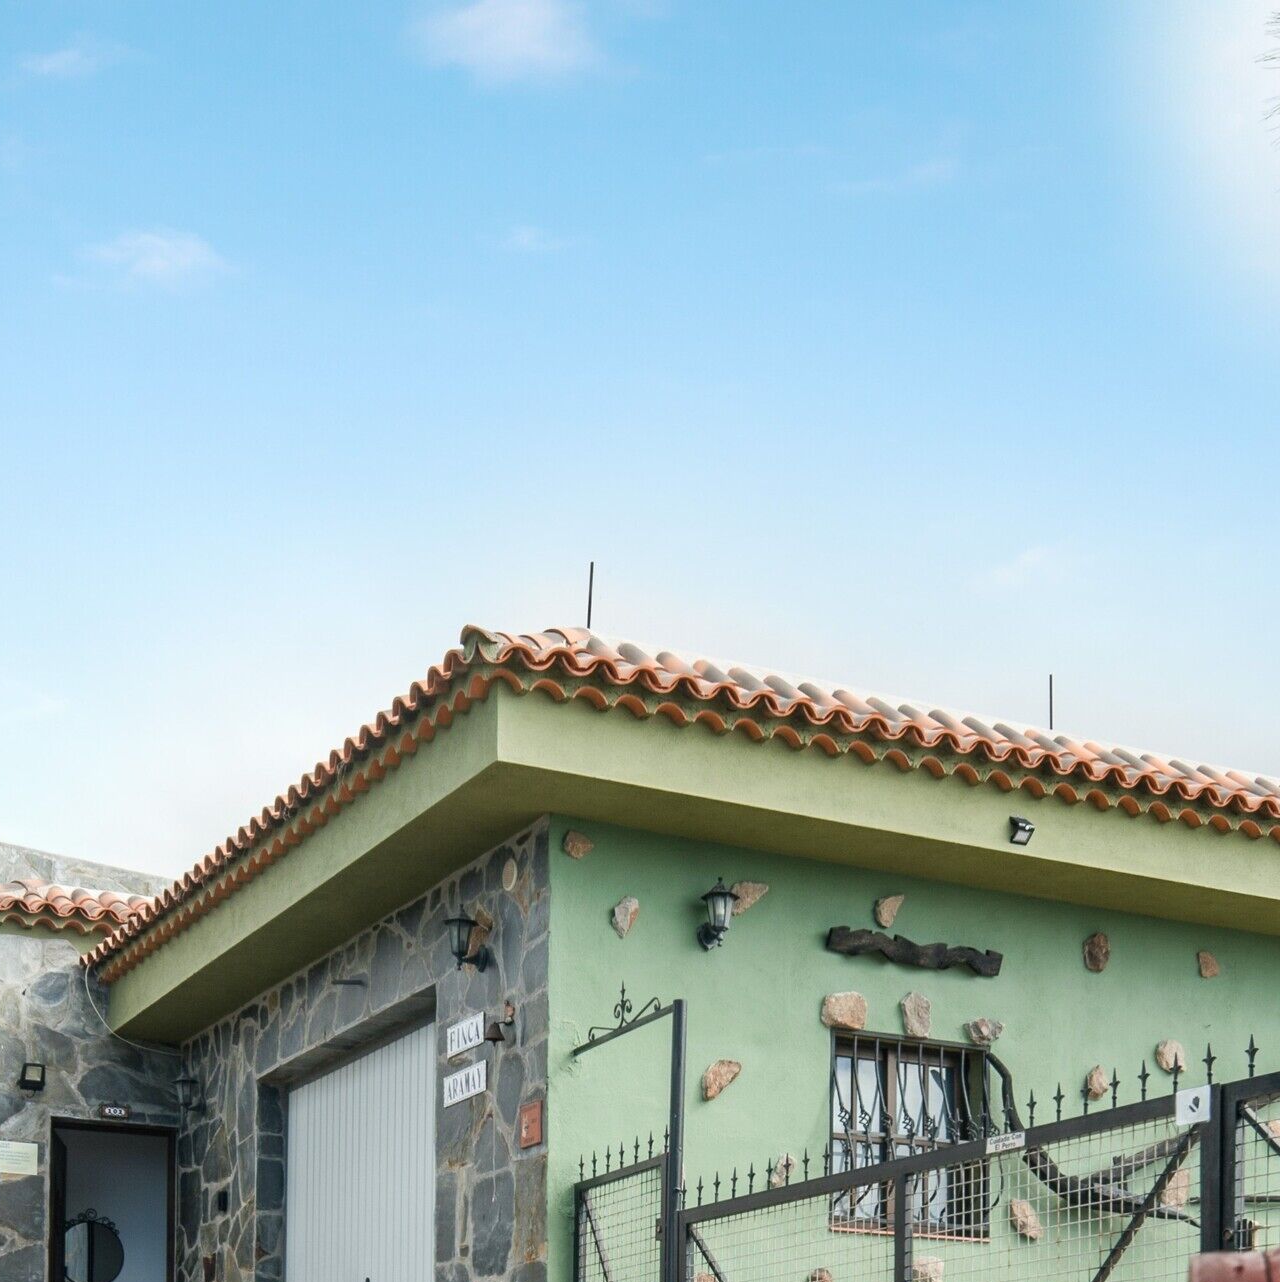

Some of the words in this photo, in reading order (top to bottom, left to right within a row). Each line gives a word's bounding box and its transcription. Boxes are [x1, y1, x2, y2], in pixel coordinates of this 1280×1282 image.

[450, 1022, 480, 1052] FINCA
[447, 1067, 482, 1101] ARAMAY
[990, 1135, 1010, 1145] Cuidado
[1002, 1142, 1016, 1150] Perro
